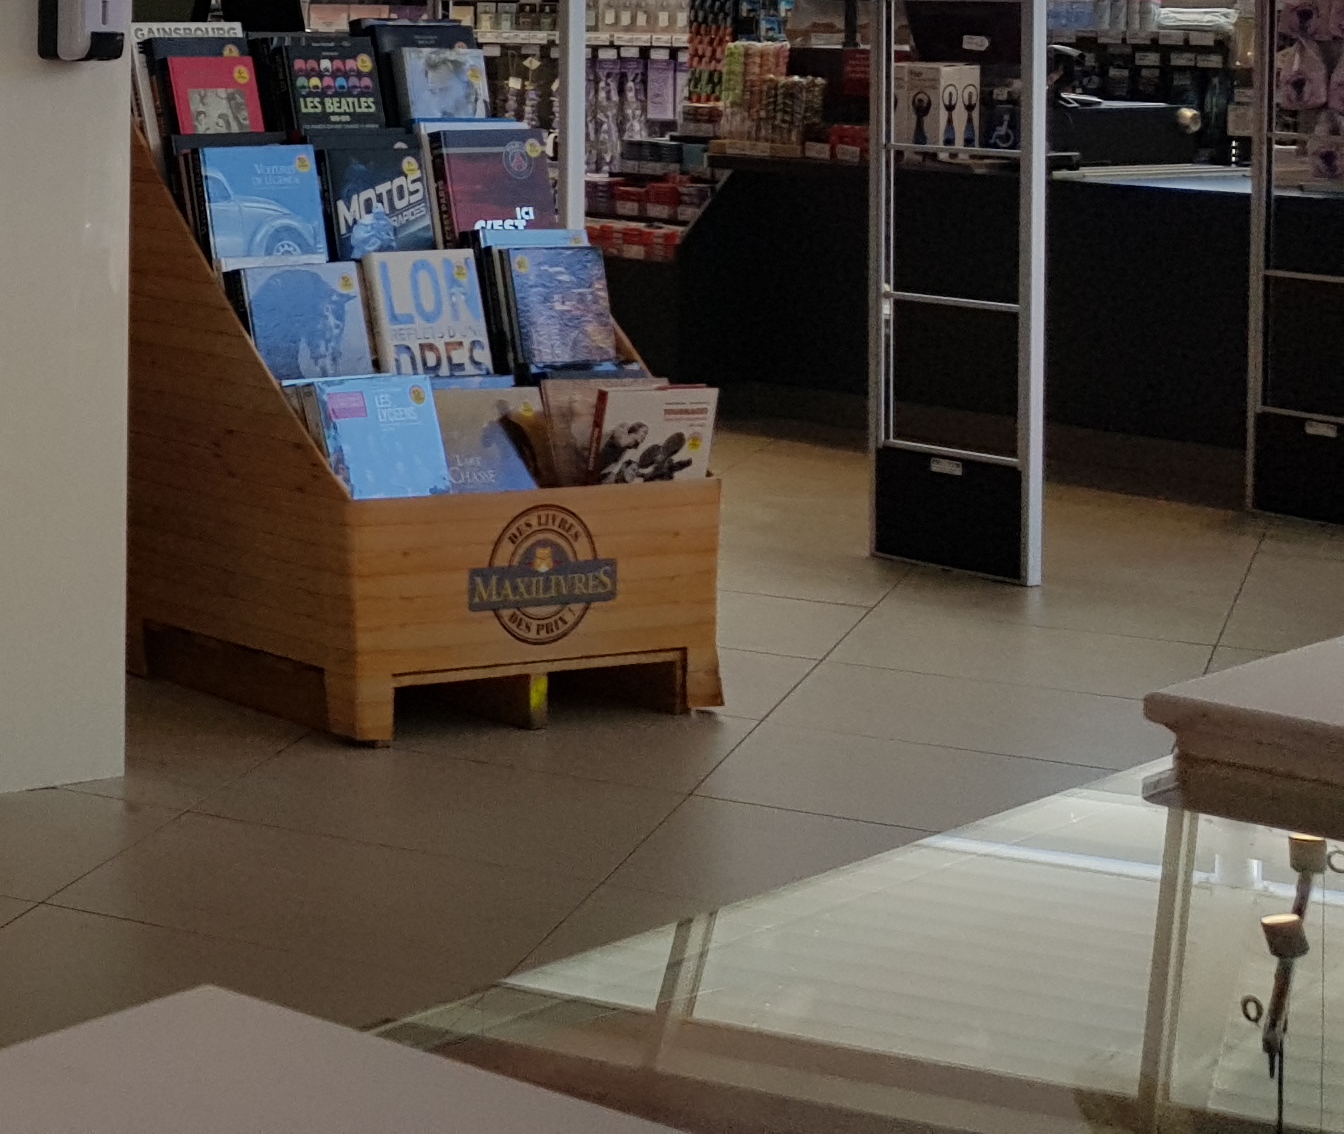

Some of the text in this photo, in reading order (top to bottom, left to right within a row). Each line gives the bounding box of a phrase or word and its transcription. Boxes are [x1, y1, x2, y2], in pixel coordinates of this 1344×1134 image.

[299, 97, 376, 113] LES BEATLES
[336, 168, 424, 236] MOTOS
[515, 206, 535, 220] ICI
[378, 257, 482, 326] LON
[508, 514, 581, 546] DES LIVRES
[472, 566, 612, 603] MAXILIVRES
